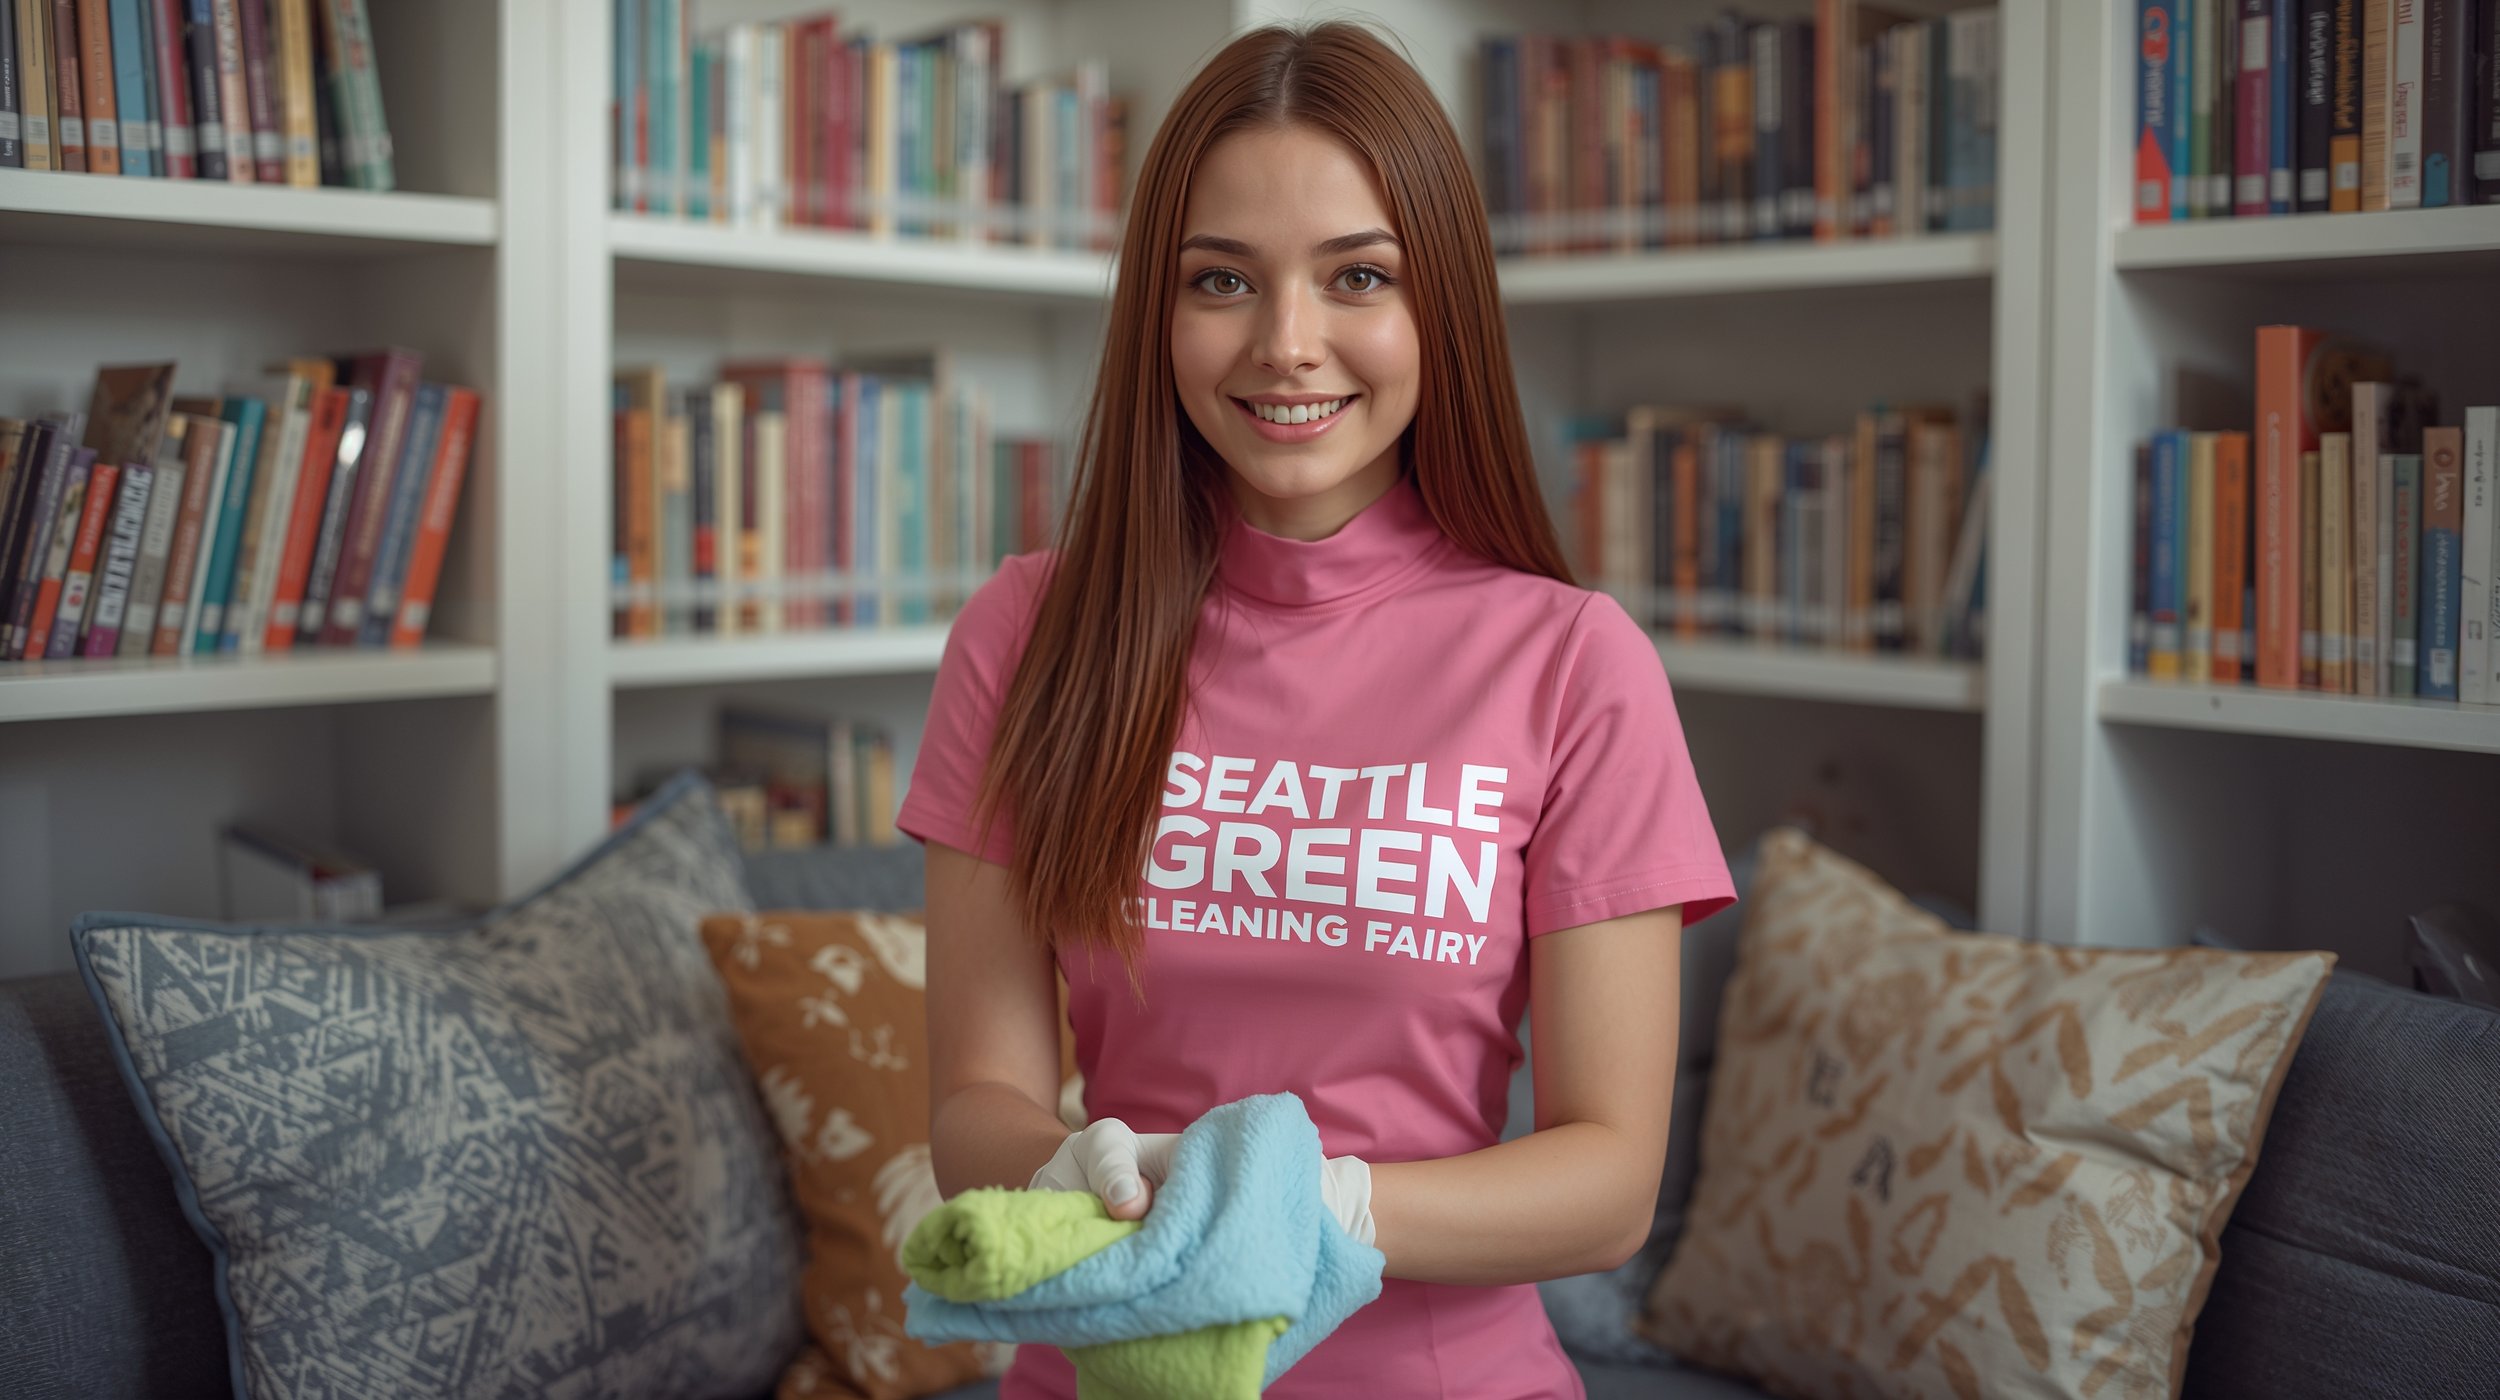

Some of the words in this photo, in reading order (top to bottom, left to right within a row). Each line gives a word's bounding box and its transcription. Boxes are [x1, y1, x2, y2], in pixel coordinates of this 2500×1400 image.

[1162, 751, 1509, 834] SEATTLE
[1142, 814, 1499, 924] GREEN
[1364, 920, 1488, 966] FAIRY
